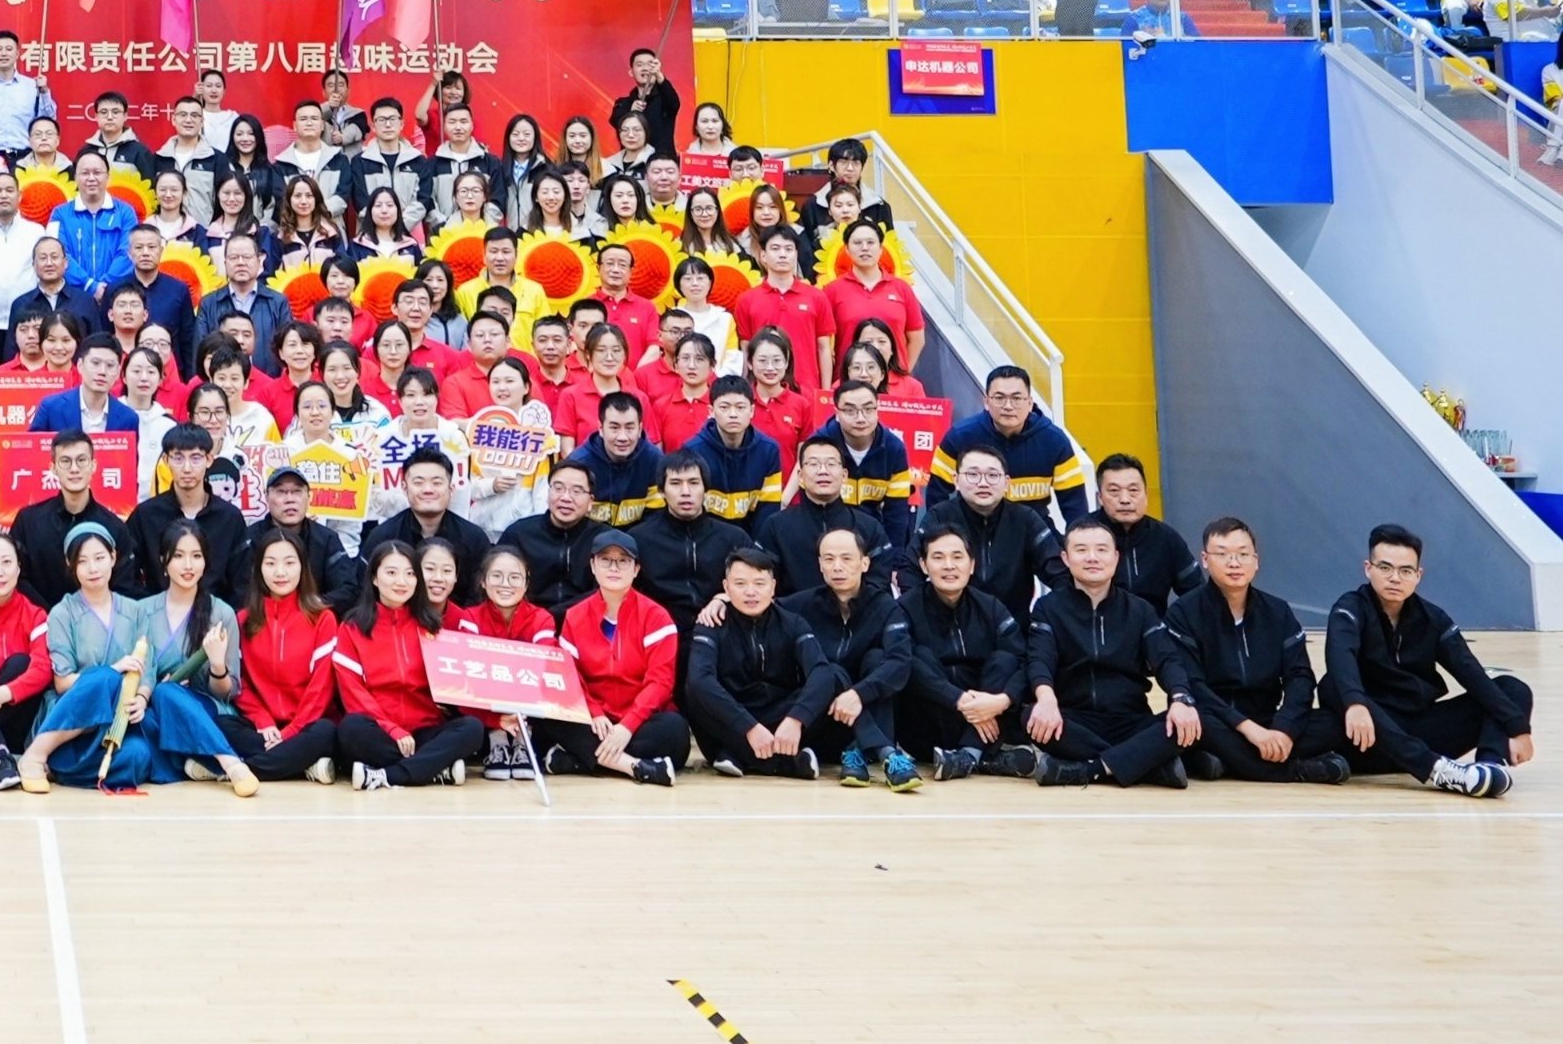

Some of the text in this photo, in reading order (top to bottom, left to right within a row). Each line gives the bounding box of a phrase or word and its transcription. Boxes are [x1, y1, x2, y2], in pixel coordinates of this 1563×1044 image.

[473, 424, 546, 454] 我能行
[11, 468, 122, 491] 广杰司
[437, 656, 566, 691] 工艺品公司
